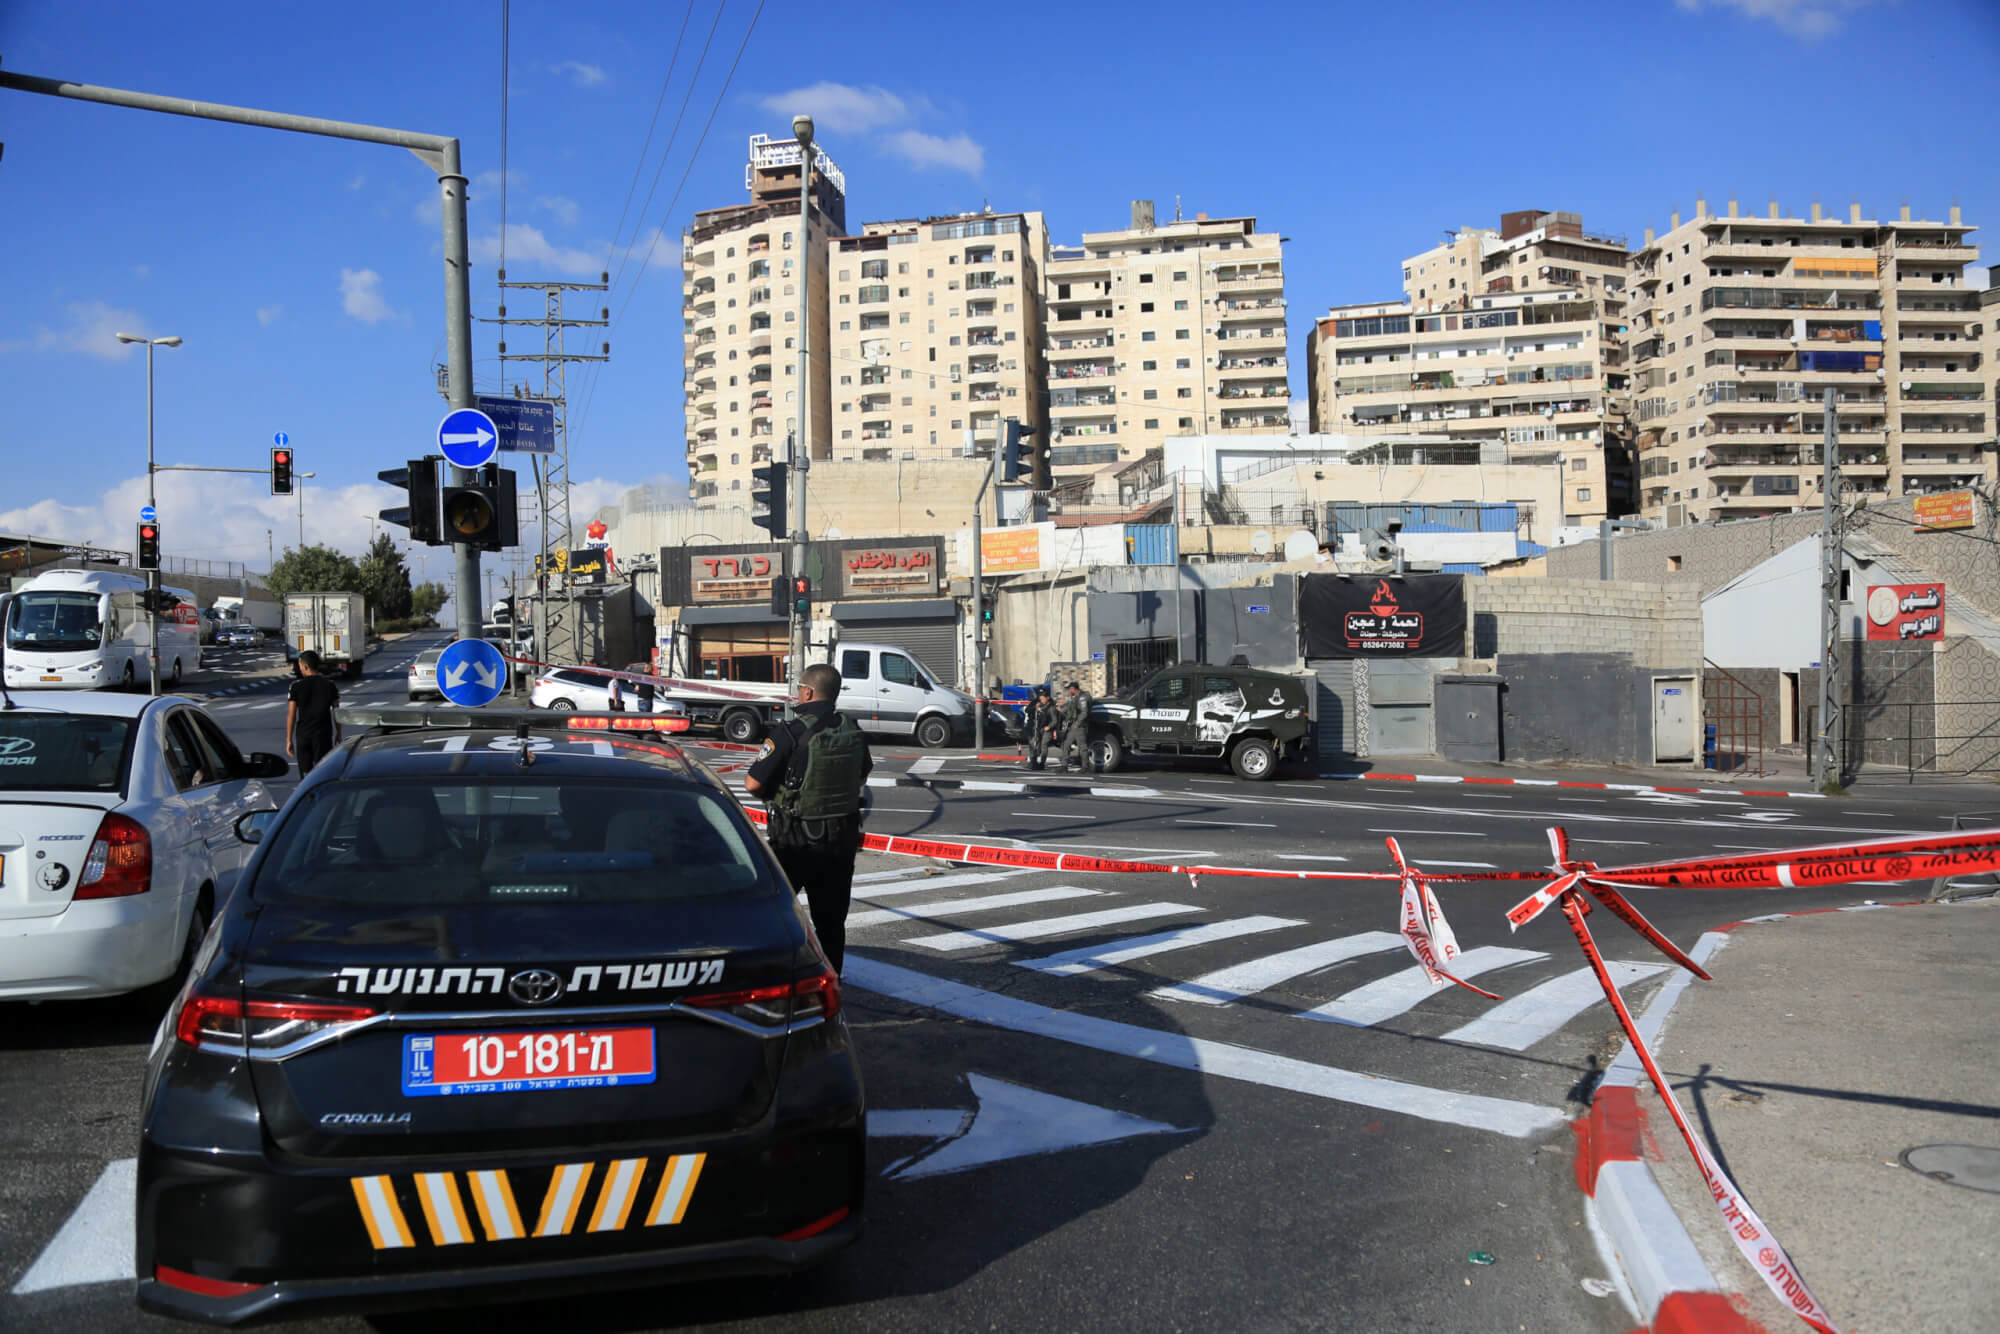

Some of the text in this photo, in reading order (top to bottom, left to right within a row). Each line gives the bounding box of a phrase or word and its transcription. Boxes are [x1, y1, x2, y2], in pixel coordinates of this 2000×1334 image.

[1348, 615, 1419, 630] لحمة و عجين
[1800, 859, 1876, 880] משטרת
[336, 959, 725, 994] משטרת התנועה
[414, 1051, 429, 1071] IL
[502, 1081, 521, 1090] 100
[528, 1079, 562, 1090] ישראל
[567, 1078, 603, 1088] משטרת
[319, 1111, 412, 1124] COROLLA
[1722, 1196, 1761, 1242] ישראל
[1769, 1263, 1815, 1315] משטרת
